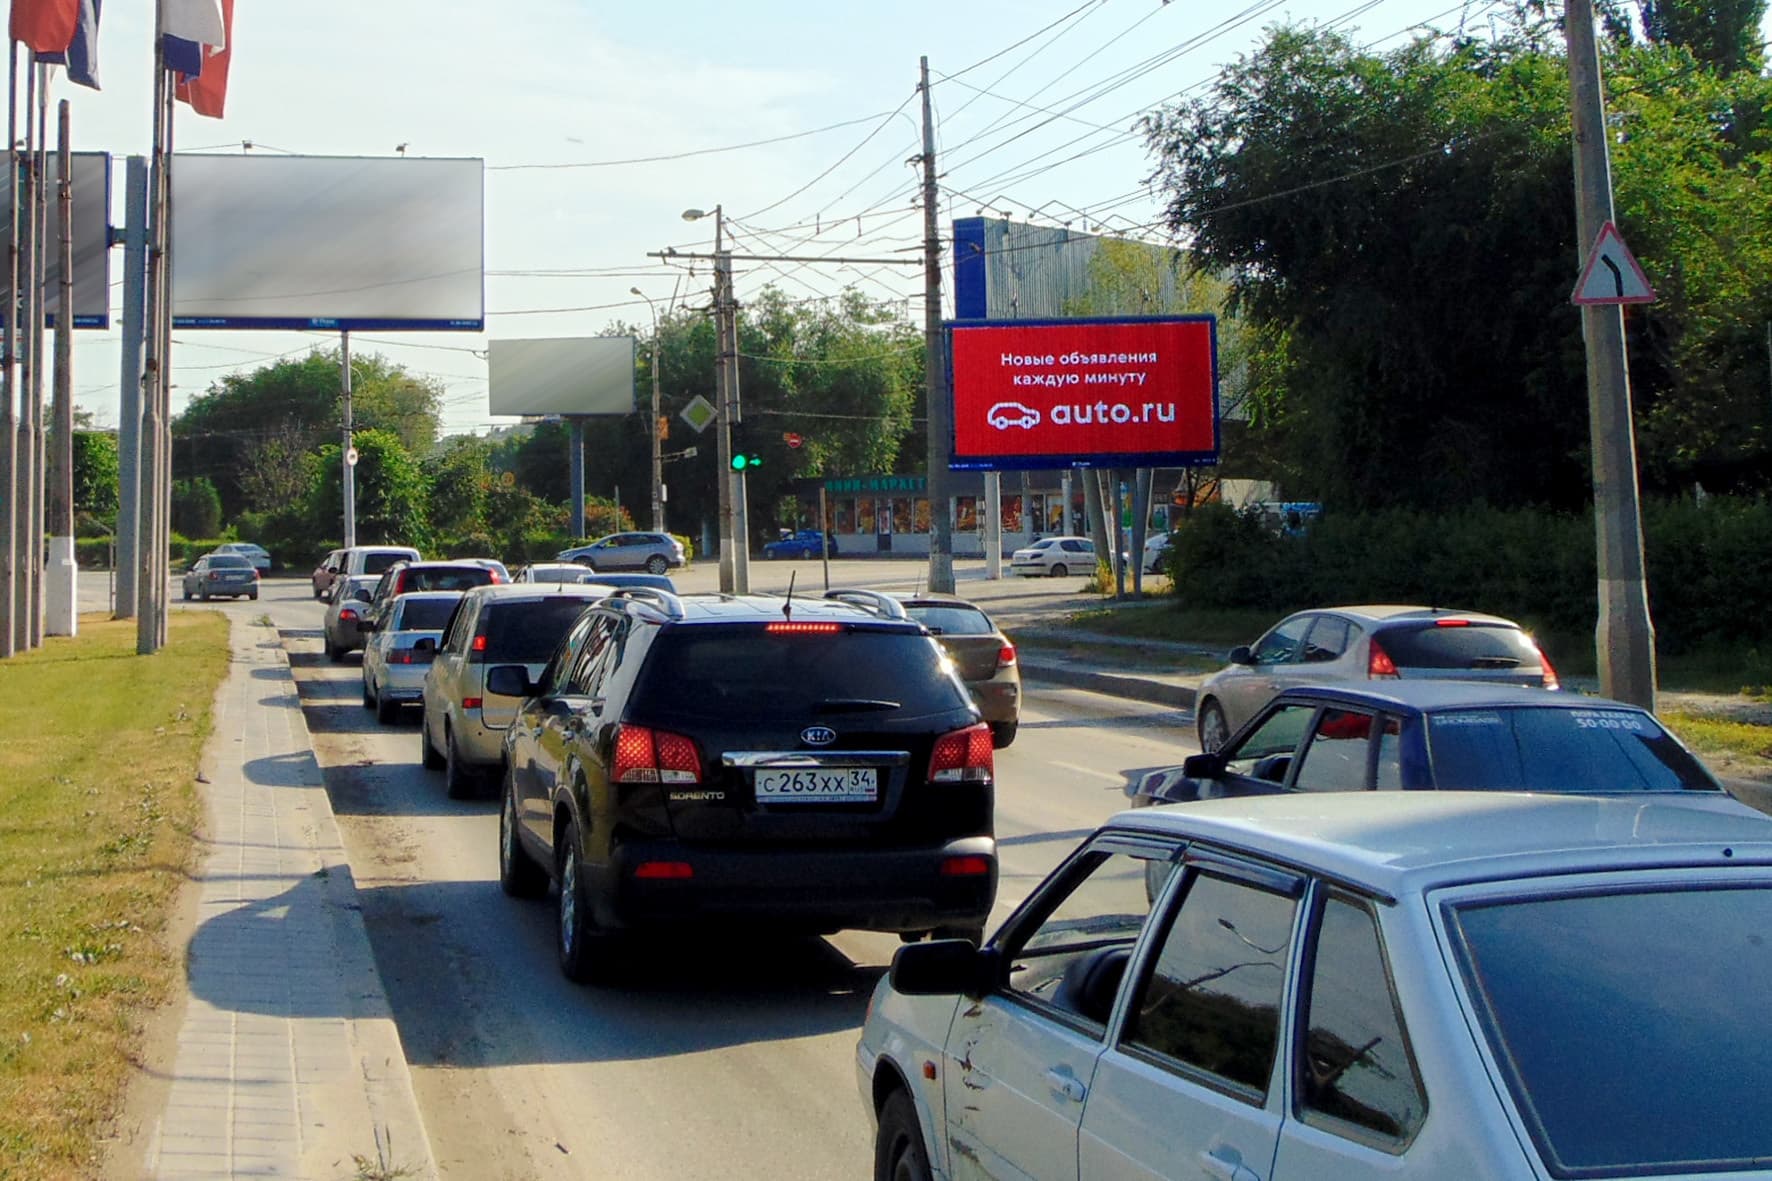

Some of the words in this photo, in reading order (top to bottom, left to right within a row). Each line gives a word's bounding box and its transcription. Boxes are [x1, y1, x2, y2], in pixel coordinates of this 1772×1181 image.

[1001, 353, 1055, 366] Новые
[1059, 351, 1158, 365] объявления
[1013, 372, 1080, 388] каждую
[1084, 371, 1147, 386] минуту
[1050, 401, 1176, 425] auto.ru
[807, 730, 830, 741] KIA
[850, 770, 871, 787] 34
[669, 791, 726, 800] SORENTO
